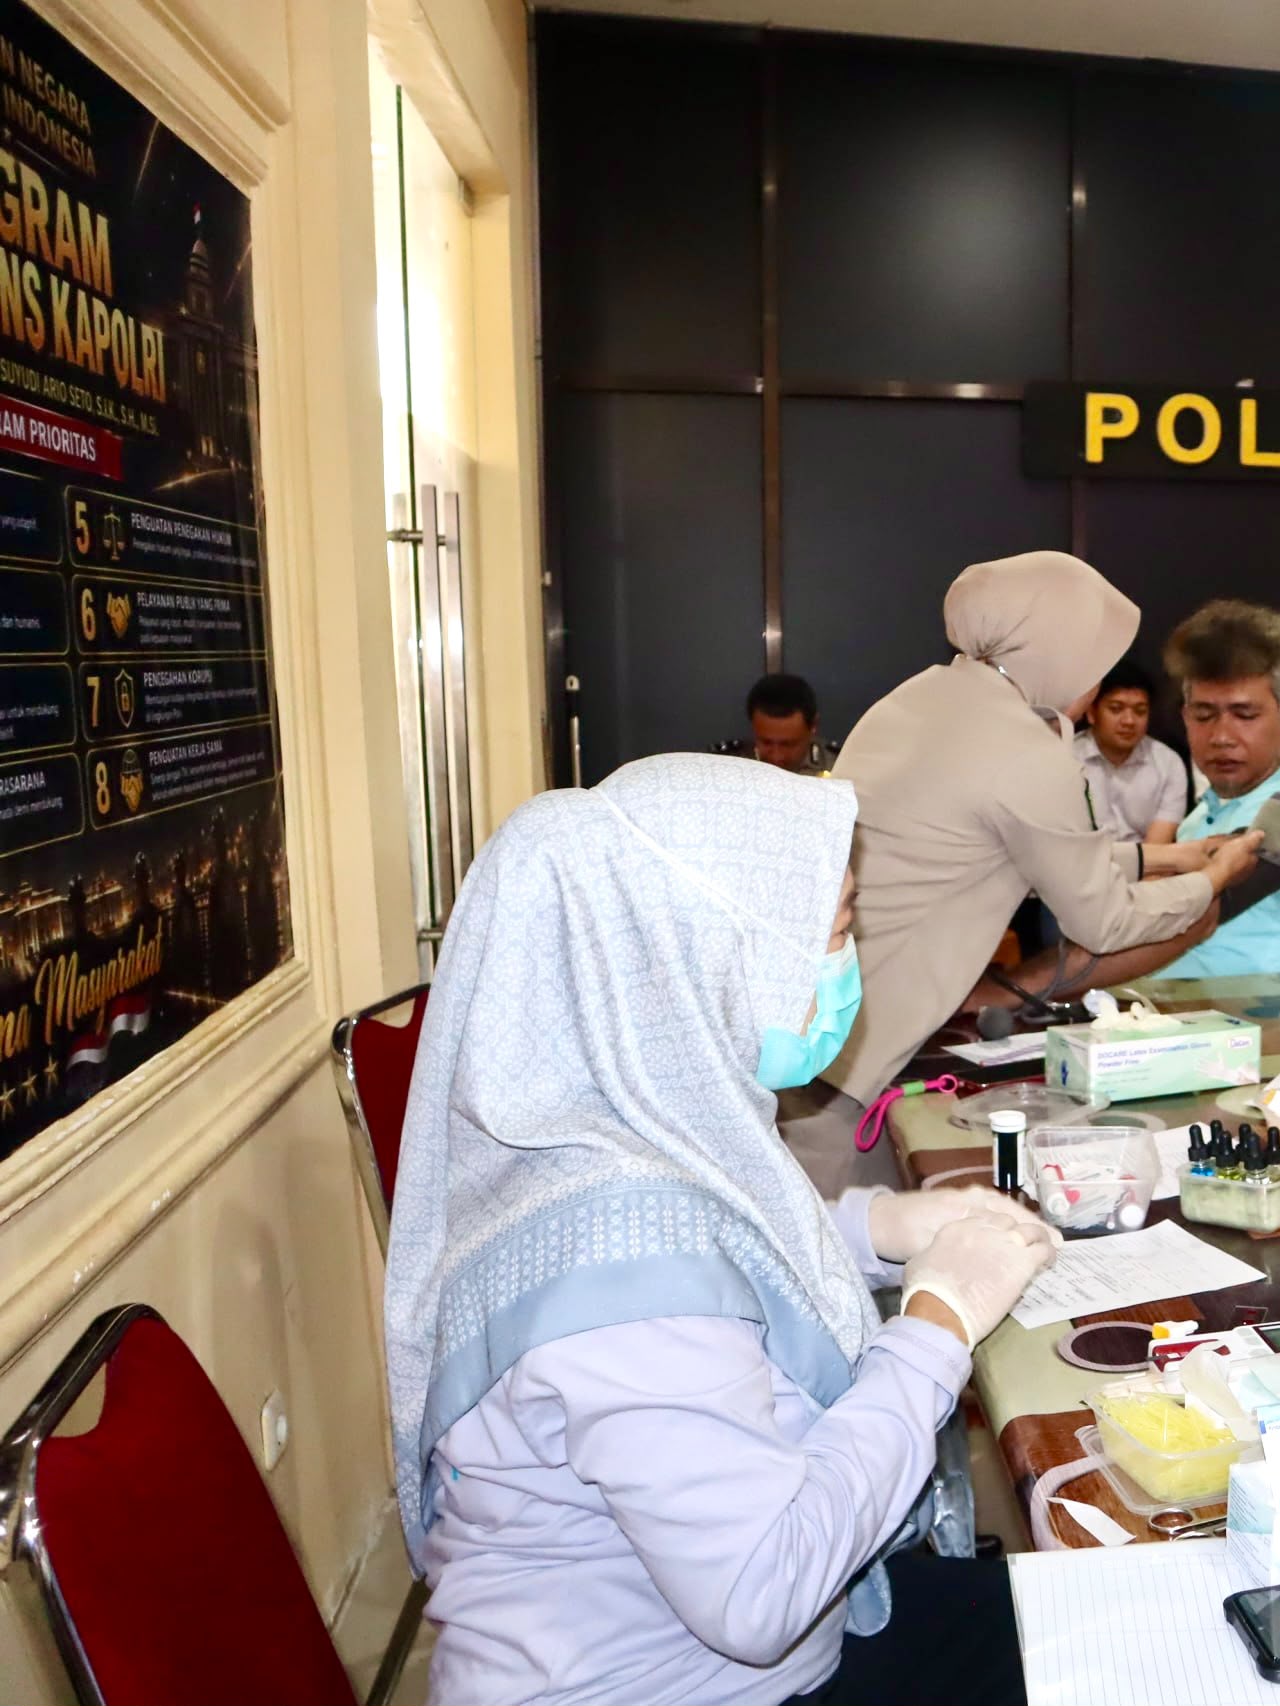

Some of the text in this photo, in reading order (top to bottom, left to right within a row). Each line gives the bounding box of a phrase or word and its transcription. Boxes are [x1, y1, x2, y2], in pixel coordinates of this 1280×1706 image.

[19, 50, 92, 136] NEGARA
[2, 83, 97, 179] INDONESIA
[51, 273, 167, 403] KAPOLRI
[43, 375, 67, 403] ARIO
[0, 408, 97, 462] AM PRIORITAS
[75, 501, 90, 554] 5
[131, 513, 174, 535] PENGUATAN
[174, 521, 211, 543] PENEGAKAN
[81, 588, 96, 641] 6
[137, 592, 175, 609] PELAYANAN
[86, 676, 100, 728] 7
[143, 670, 187, 688] PENCEGAHAN
[149, 745, 187, 767] PENGUATAN
[188, 742, 206, 758] KERJA
[95, 761, 110, 815] 8
[35, 916, 162, 1045] Masyarakat
